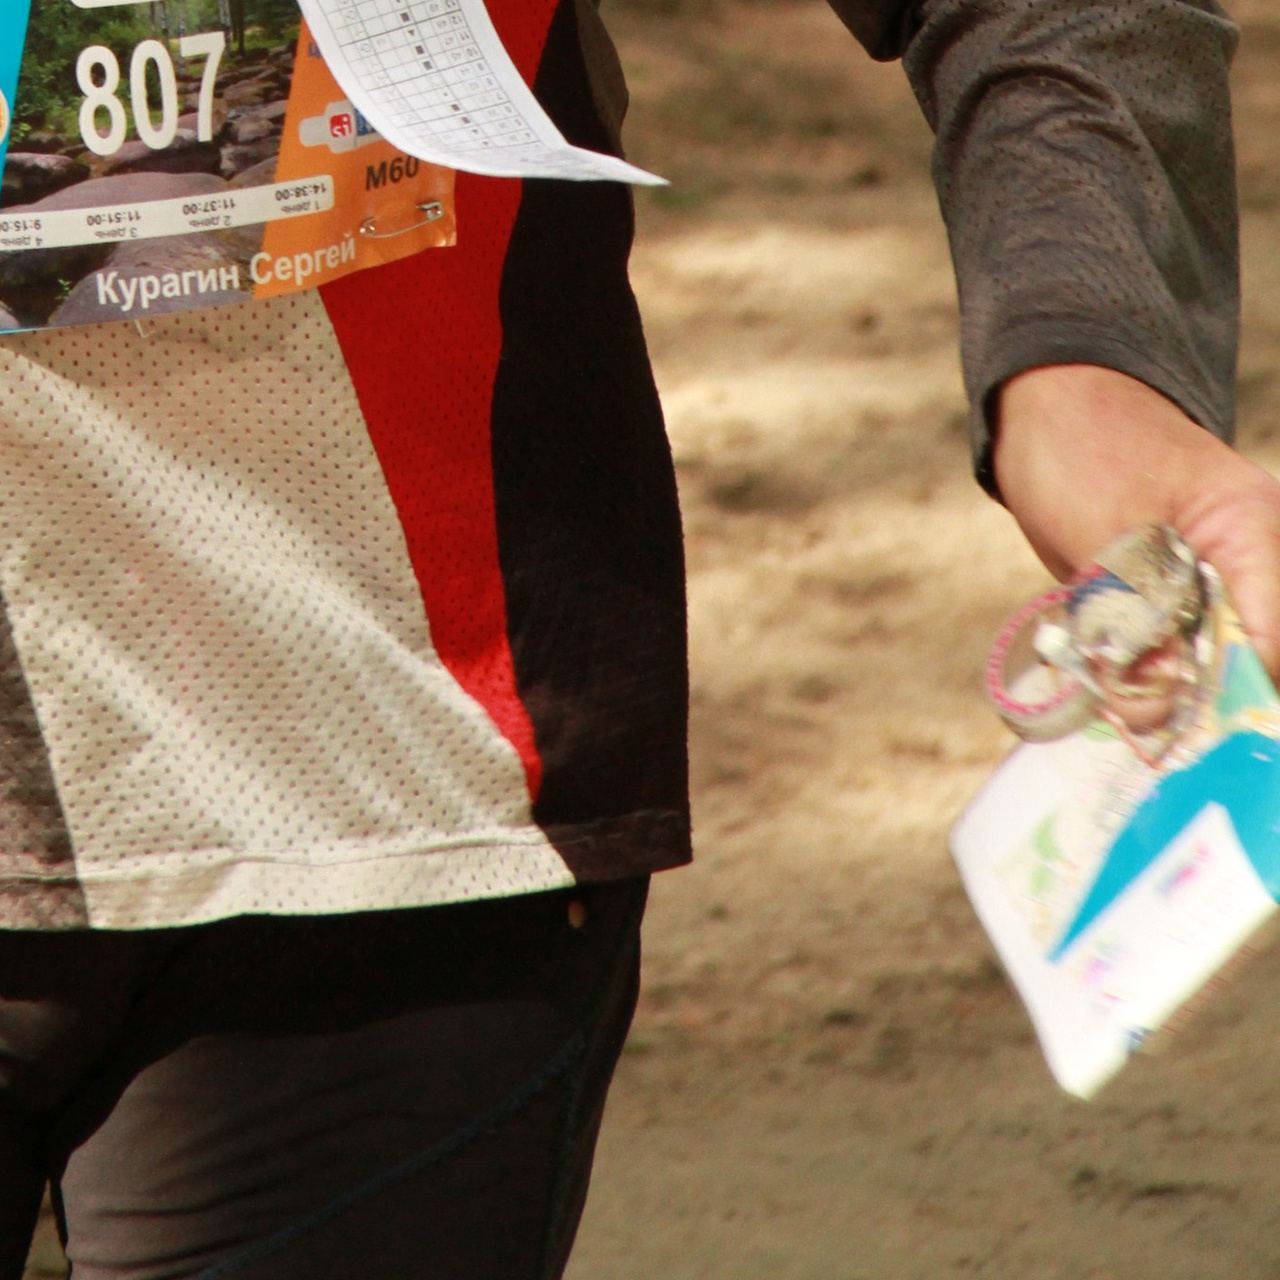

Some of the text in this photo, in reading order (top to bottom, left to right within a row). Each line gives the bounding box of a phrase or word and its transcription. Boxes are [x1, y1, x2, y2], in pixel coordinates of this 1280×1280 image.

[75, 31, 228, 156] 807
[275, 182, 326, 201] 14:38:00
[182, 197, 236, 215] 11:37:00
[86, 210, 141, 226] 11:51:00
[188, 217, 222, 228] день
[0, 236, 32, 247] день
[94, 228, 127, 239] день
[96, 233, 356, 311] Курагин Сергей
